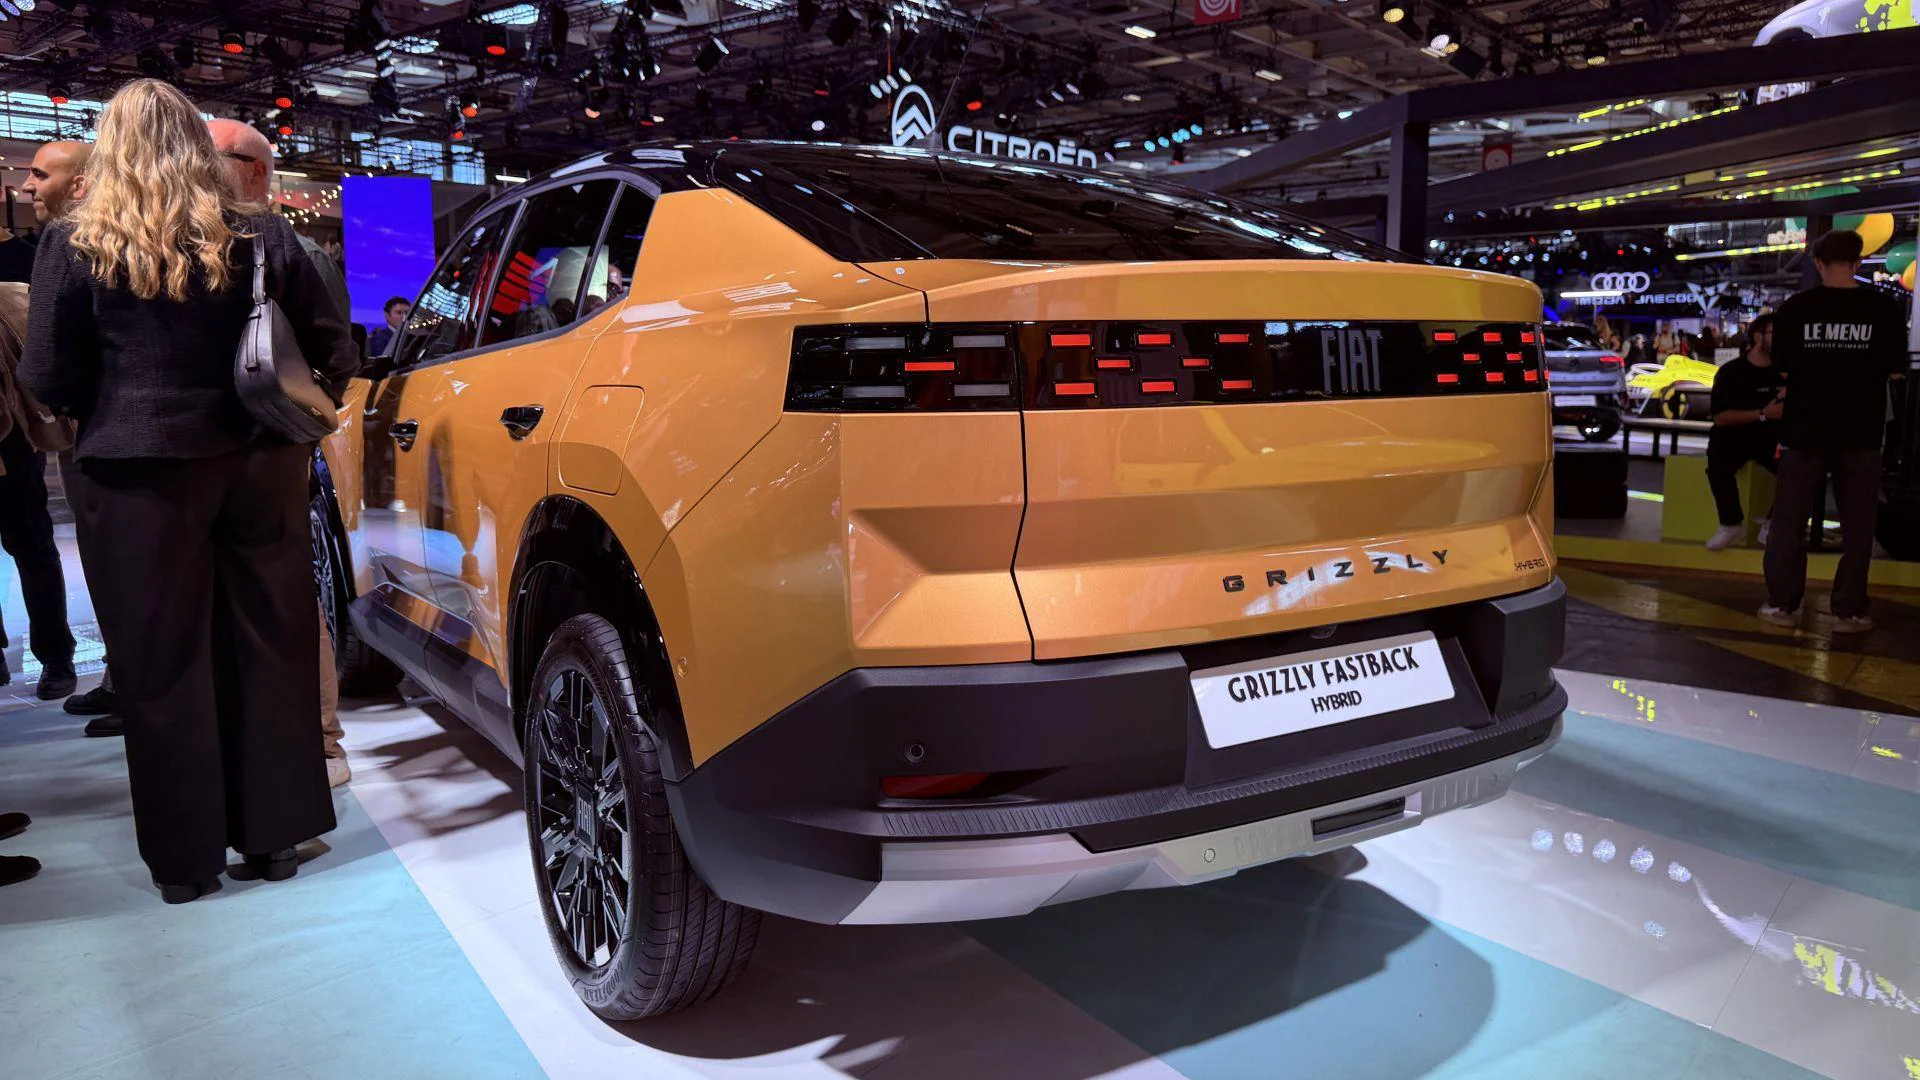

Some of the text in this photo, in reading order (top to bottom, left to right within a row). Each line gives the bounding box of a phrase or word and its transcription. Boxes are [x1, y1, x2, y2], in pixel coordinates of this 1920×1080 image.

[948, 125, 1098, 169] CITROËN
[1804, 322, 1873, 341] LE MENU
[1320, 327, 1383, 394] FIAT
[1222, 549, 1449, 593] GRIZZLY
[1514, 557, 1546, 573] HYBRID
[1227, 646, 1420, 703] GRIZZLY FASTBACK
[1311, 690, 1363, 715] HYBRID
[577, 795, 592, 836] FIAT
